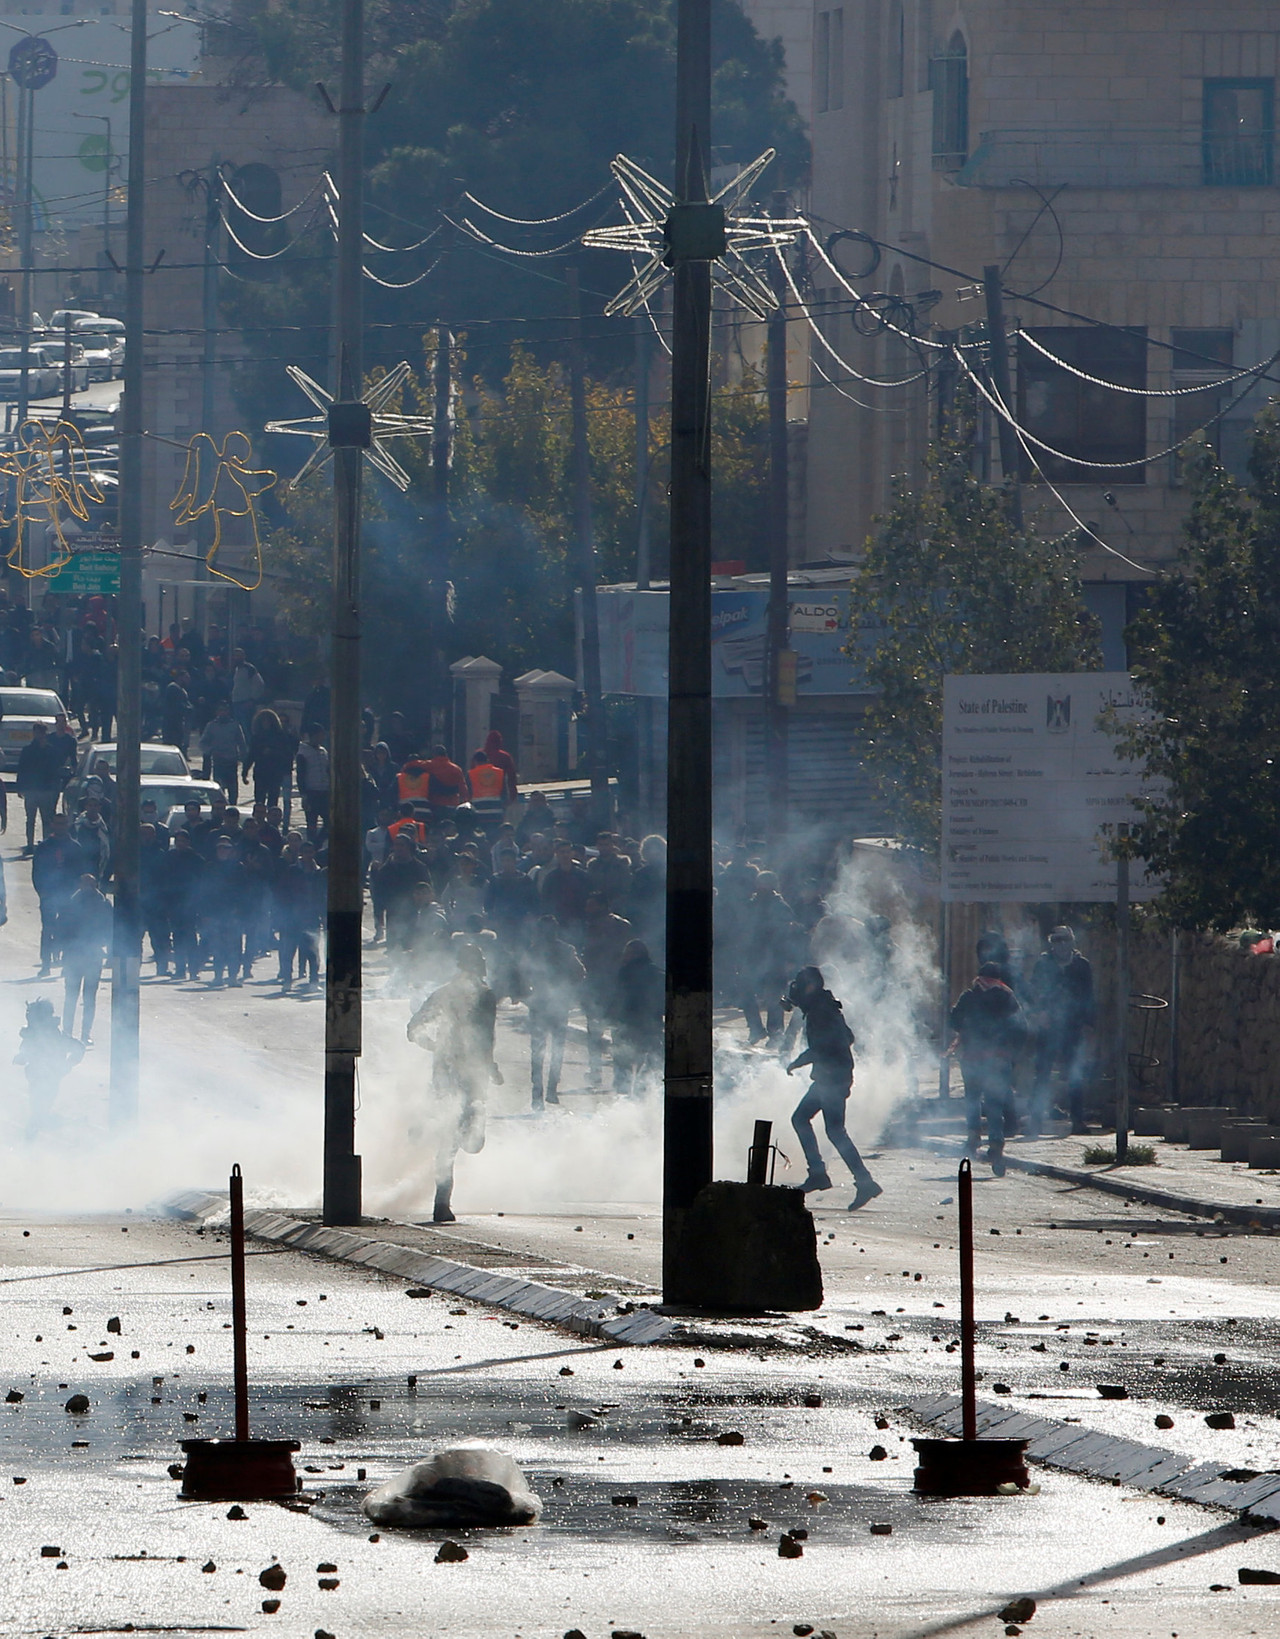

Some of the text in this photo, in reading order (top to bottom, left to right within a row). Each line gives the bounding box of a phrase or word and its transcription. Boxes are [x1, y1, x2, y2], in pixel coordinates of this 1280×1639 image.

[711, 606, 750, 628] elpak
[794, 607, 838, 617] ALDO
[958, 699, 1029, 714] State of Palestine
